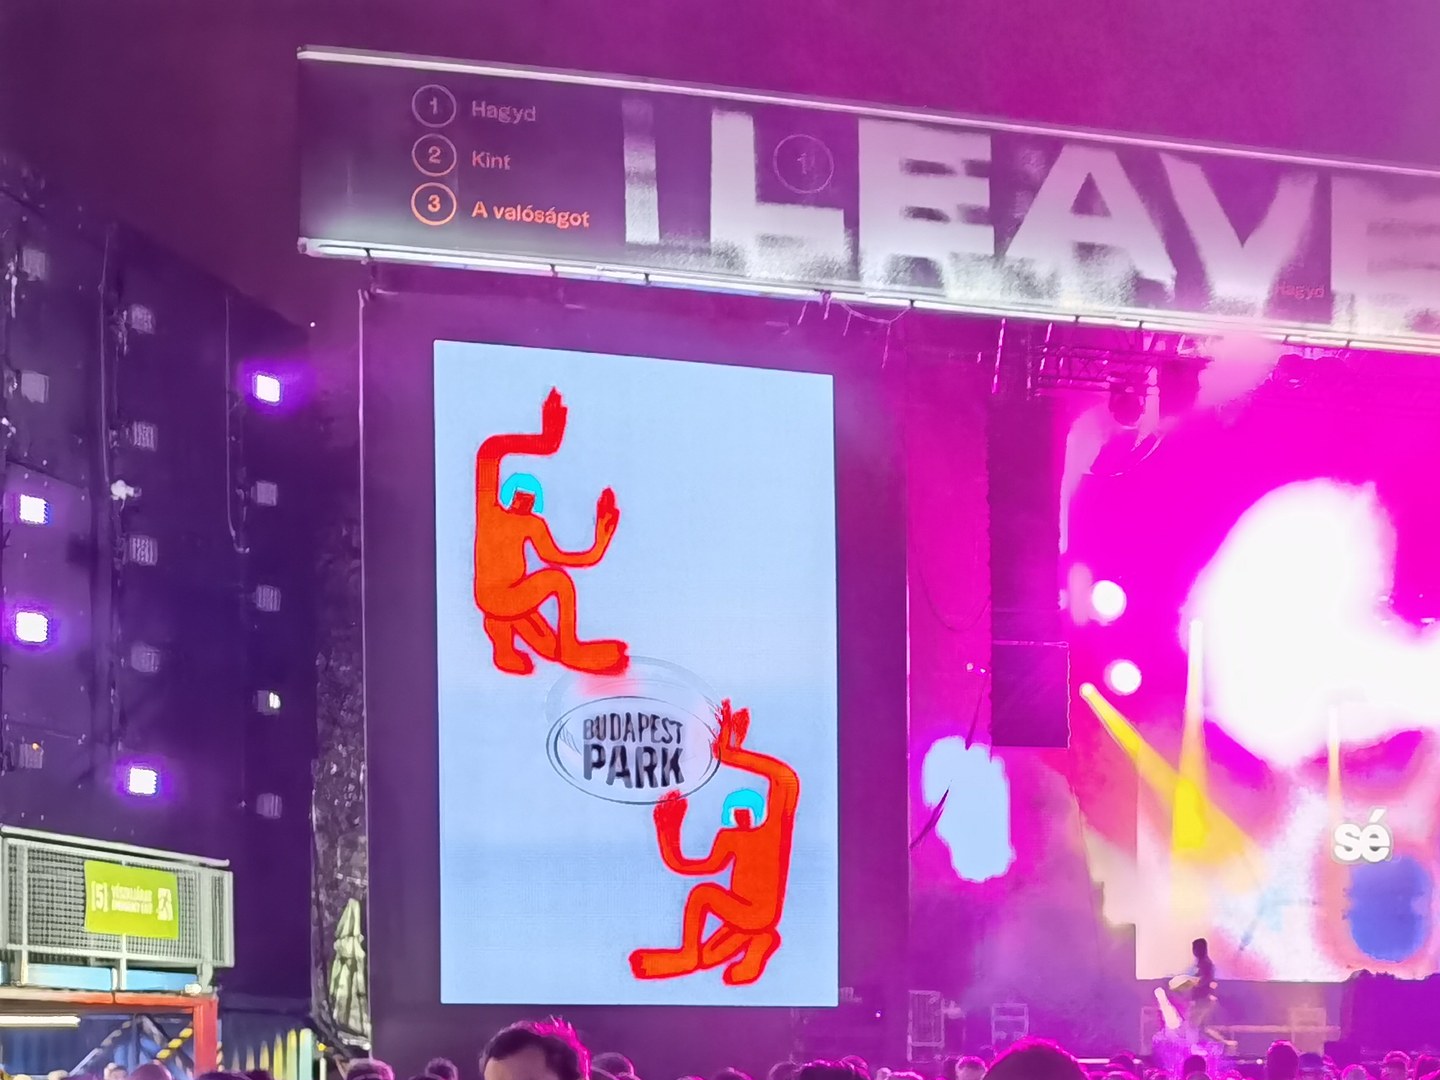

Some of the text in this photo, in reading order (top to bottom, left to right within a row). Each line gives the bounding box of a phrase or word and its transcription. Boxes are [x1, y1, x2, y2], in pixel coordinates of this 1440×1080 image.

[471, 100, 537, 124] Hagyd
[471, 149, 512, 171] Kint
[471, 200, 489, 219] A
[493, 204, 590, 229] valóságot
[582, 711, 684, 744] BUDAPEST
[582, 742, 685, 789] PARK
[1333, 807, 1391, 863] sé
